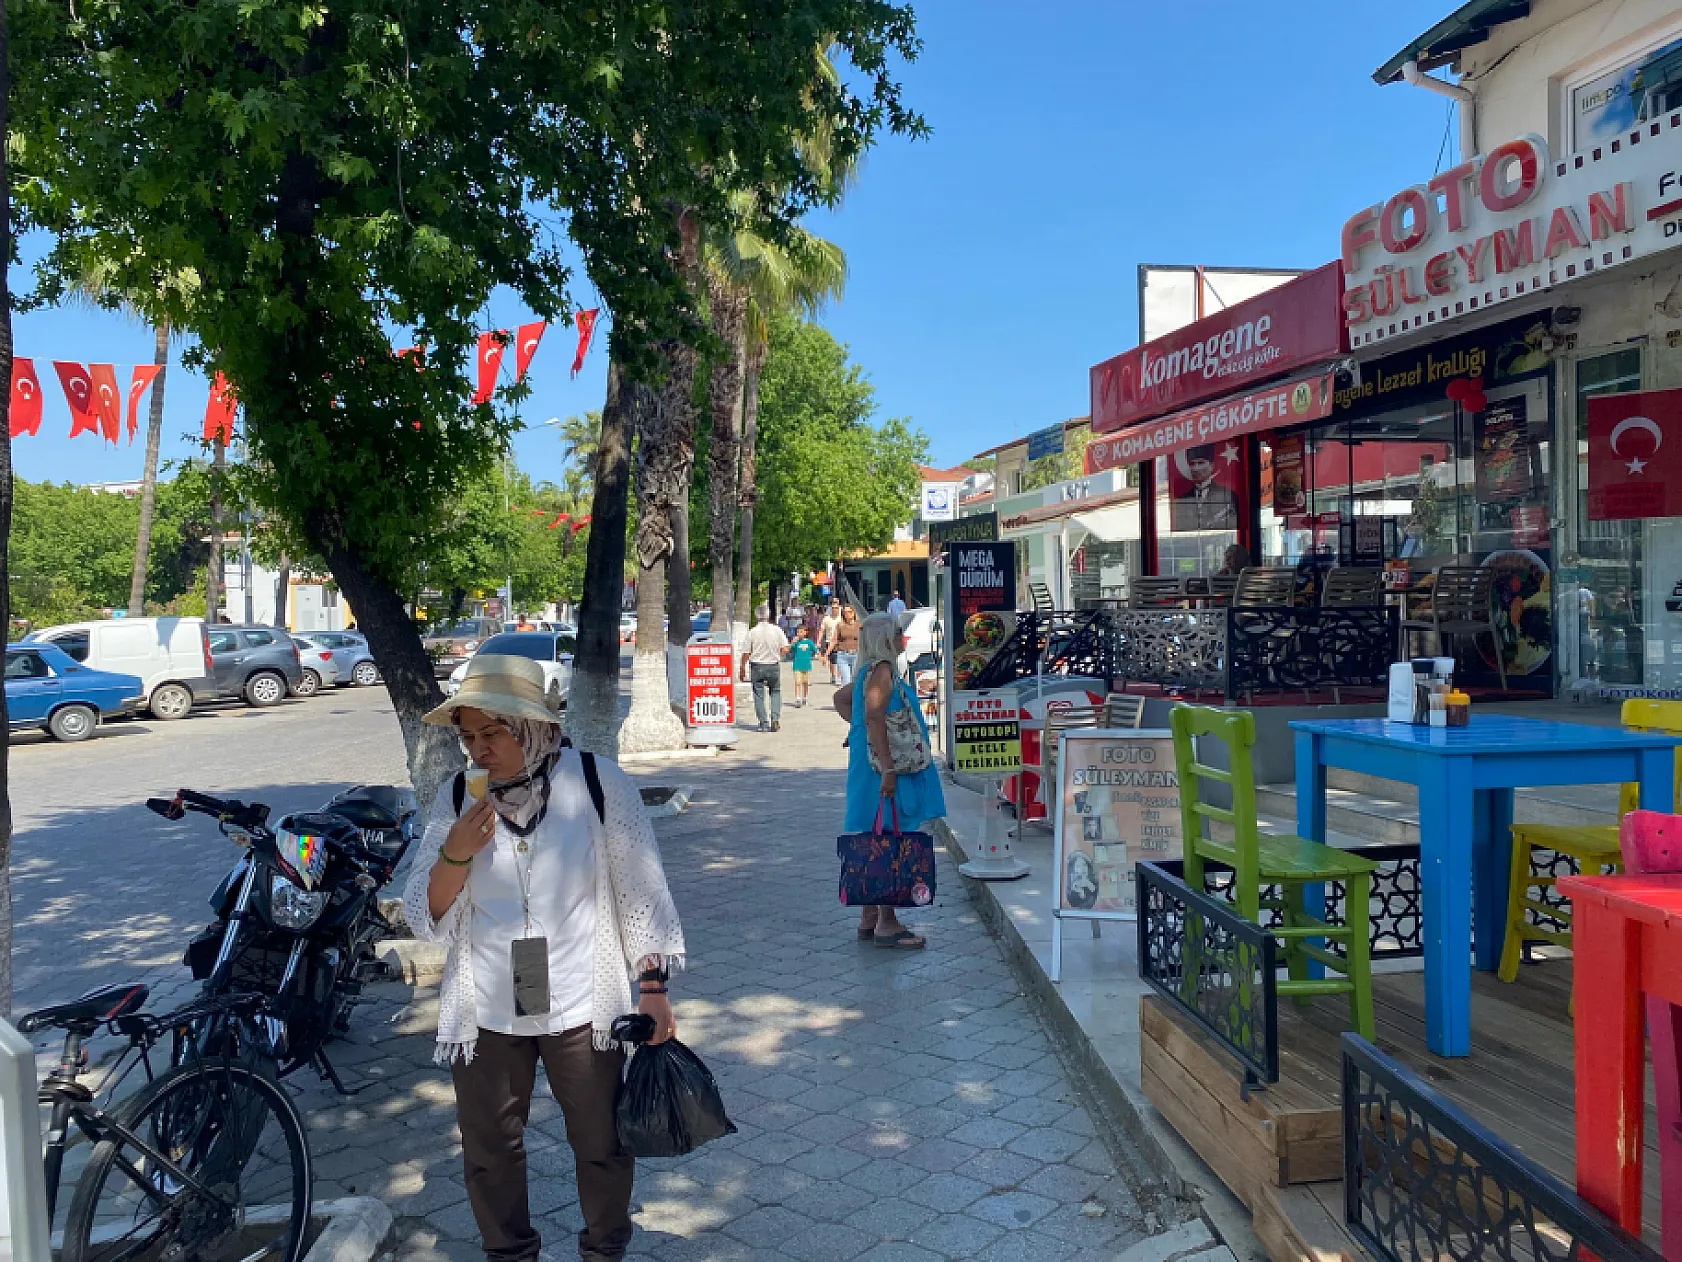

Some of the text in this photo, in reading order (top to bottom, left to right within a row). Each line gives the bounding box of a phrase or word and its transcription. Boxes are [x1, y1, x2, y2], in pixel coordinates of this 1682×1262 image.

[1342, 136, 1543, 273] FOTO
[1342, 182, 1633, 327] SÜLEYMAN
[1140, 314, 1271, 389] komagene
[1112, 392, 1287, 460] KOMAGENE ÇİĞKÖFTE
[959, 549, 995, 567] MEGA
[959, 567, 1004, 588] DÜRÜM
[968, 698, 1002, 710] FOTO
[955, 709, 1017, 721] SÜLEYMAN
[956, 723, 1017, 739] FOTOKOPİ
[970, 742, 1007, 755] ACELE
[1101, 746, 1156, 764] FOTO
[1073, 765, 1180, 787] SÜLEYMAN
